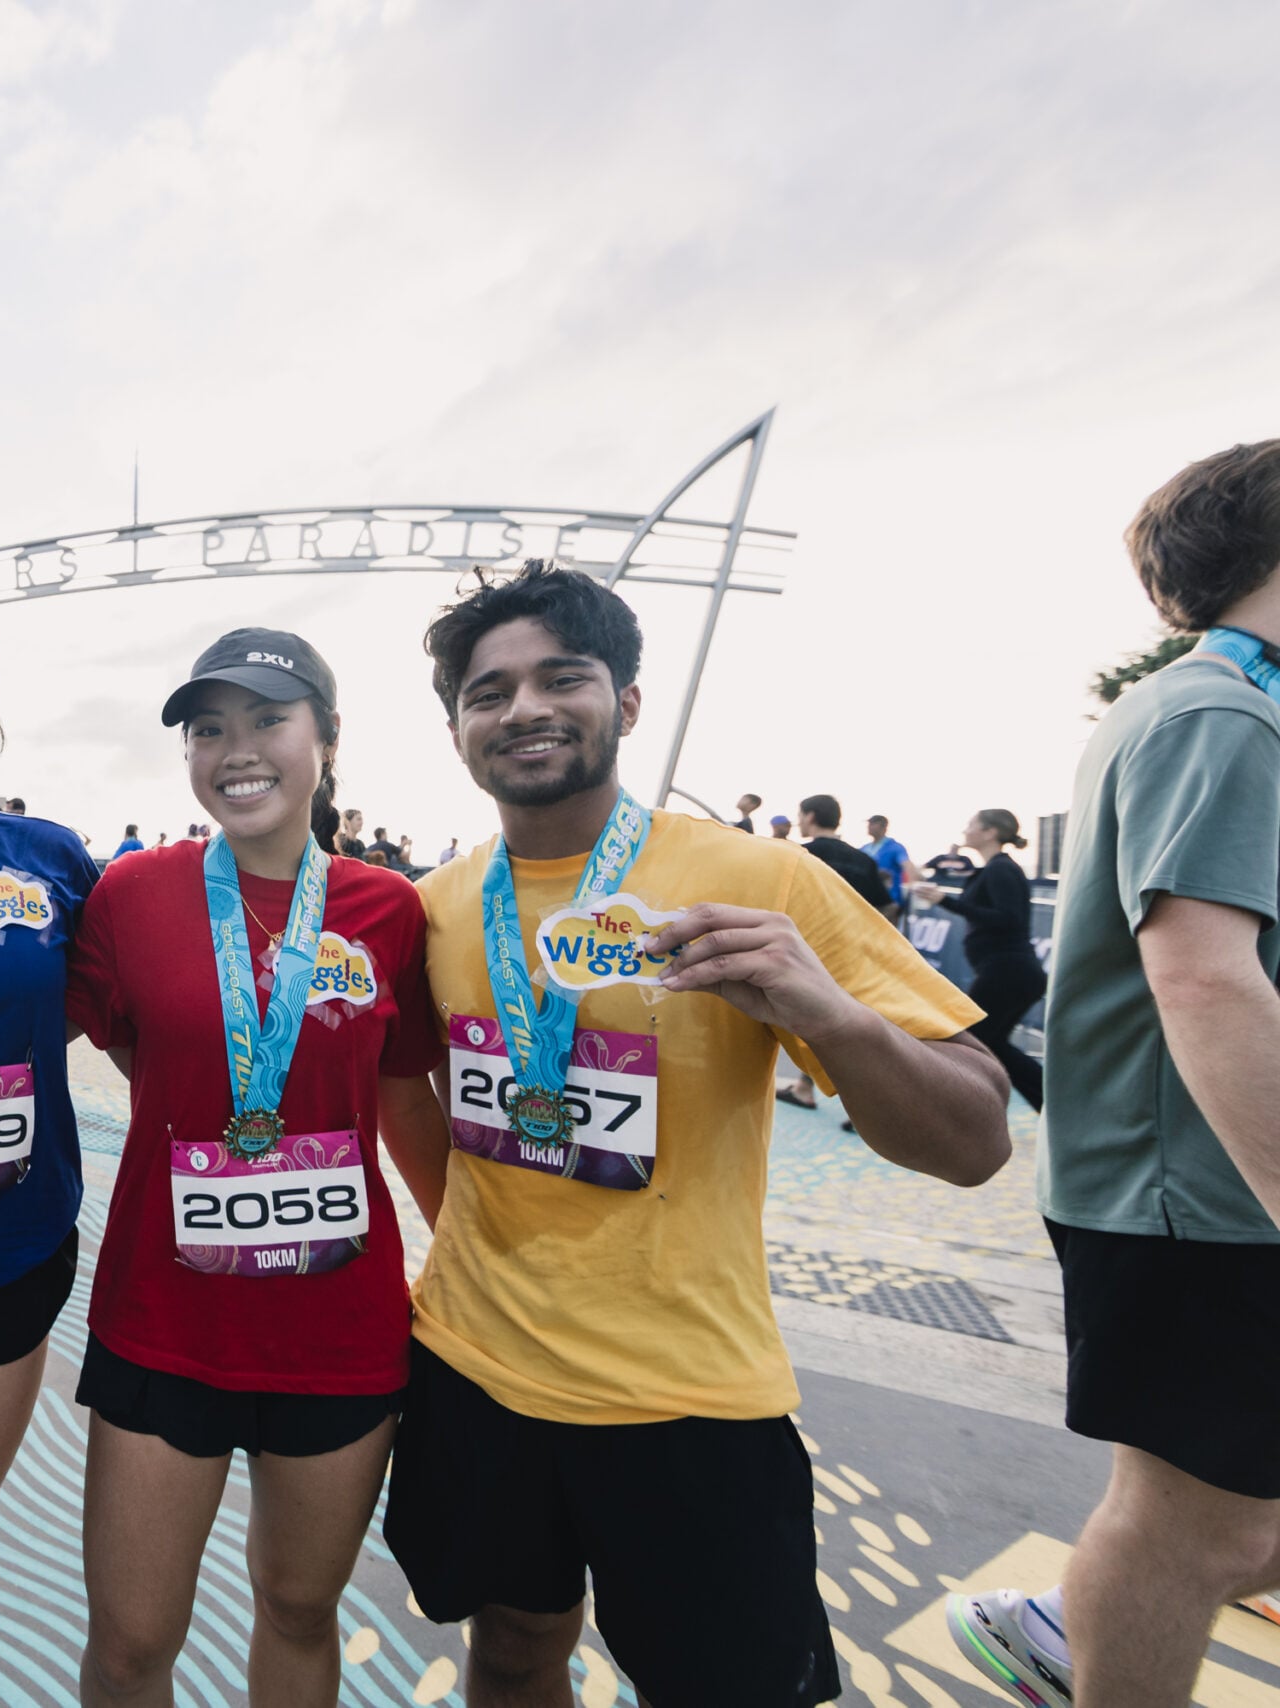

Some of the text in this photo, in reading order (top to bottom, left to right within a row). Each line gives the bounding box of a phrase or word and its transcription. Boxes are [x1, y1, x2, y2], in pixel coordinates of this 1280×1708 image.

[202, 521, 580, 562] PARADISE
[246, 651, 294, 669] 2XU
[615, 807, 640, 846] 2026
[297, 884, 318, 952] FINISHER
[591, 912, 633, 934] The
[318, 943, 341, 959] he
[493, 894, 517, 989] GOLD COAST
[221, 922, 245, 1018] GOLD COAST
[311, 959, 374, 993] ggles
[196, 1155, 202, 1167] C
[517, 1140, 564, 1167] 10KM
[182, 1184, 360, 1230] 2058
[254, 1248, 297, 1269] 10KM
